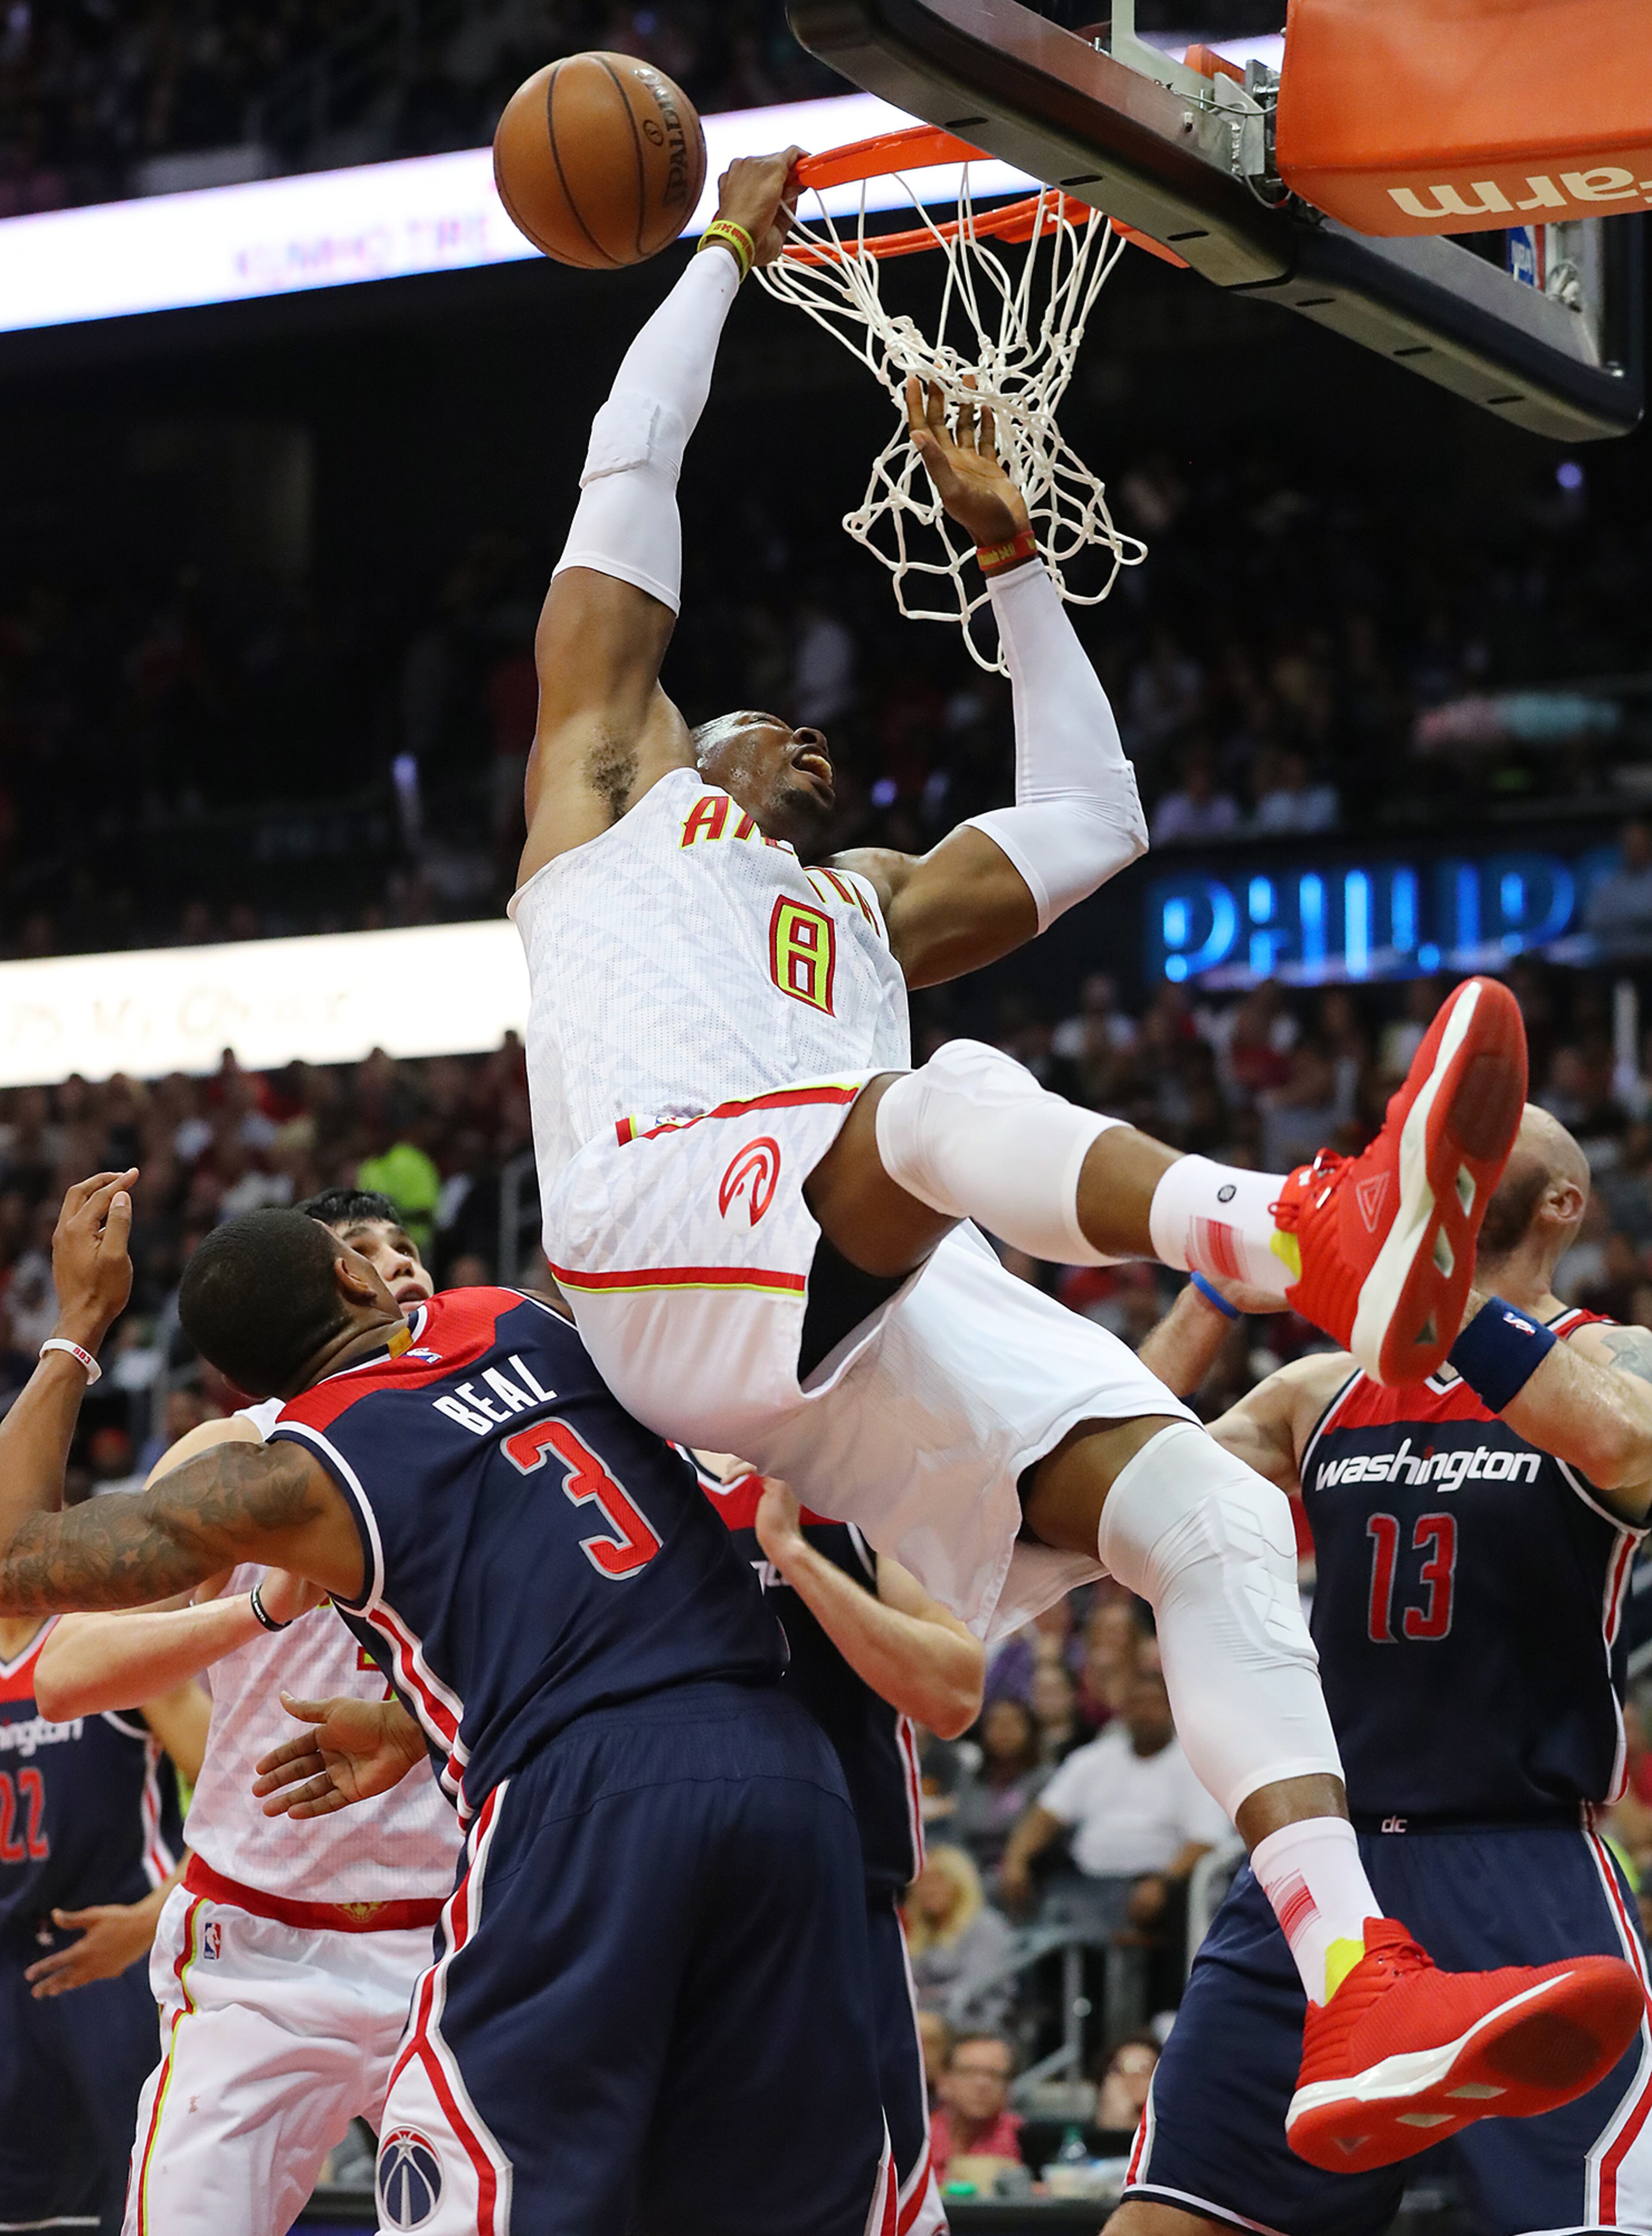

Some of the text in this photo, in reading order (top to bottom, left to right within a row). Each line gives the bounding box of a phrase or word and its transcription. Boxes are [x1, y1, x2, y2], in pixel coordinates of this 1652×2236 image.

[632, 68, 689, 207] SPALDING
[1387, 166, 1652, 218] arm
[769, 894, 836, 1018] 8
[1162, 859, 1580, 983] PHILIP
[432, 1354, 558, 1436] BEAL
[500, 1417, 664, 1581] 3
[1315, 1438, 1541, 1492] washington
[1366, 1512, 1458, 1644] 13
[0, 1714, 84, 1757] ington
[0, 1766, 49, 1863] 22
[1381, 1815, 1407, 1833] dc
